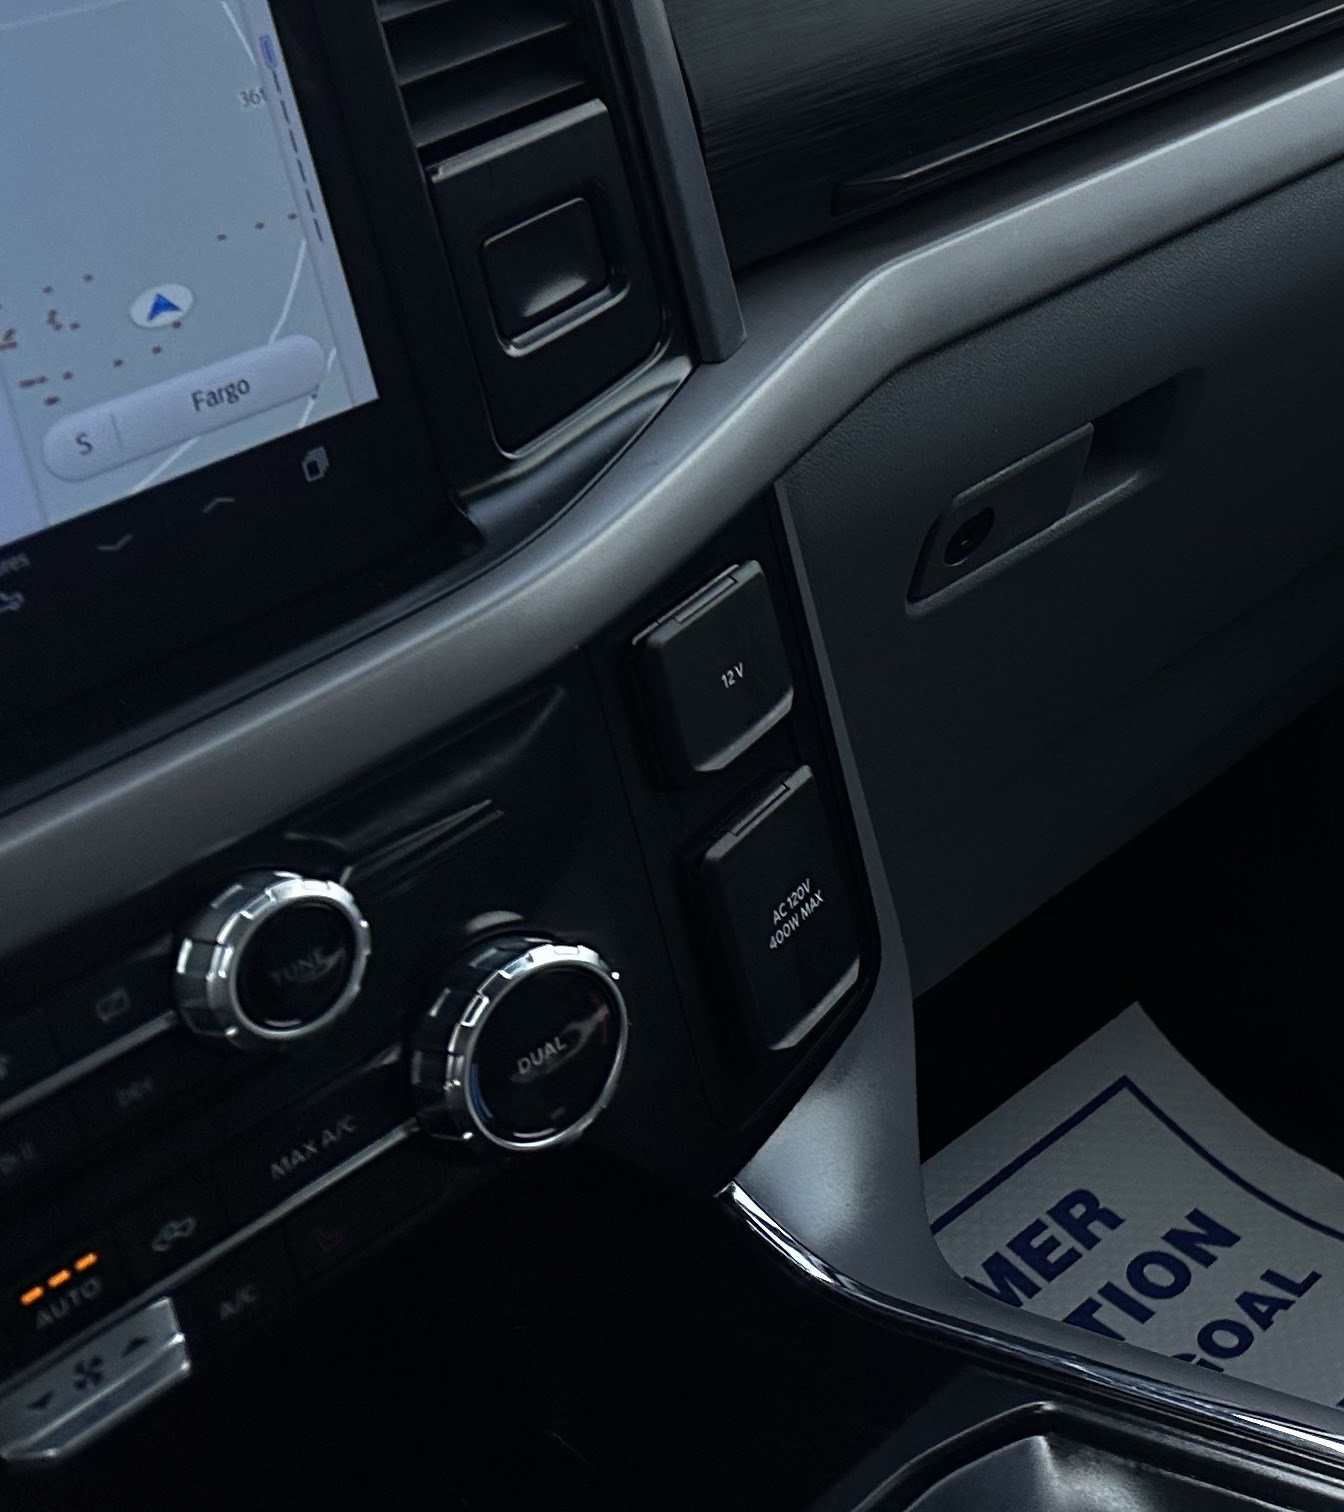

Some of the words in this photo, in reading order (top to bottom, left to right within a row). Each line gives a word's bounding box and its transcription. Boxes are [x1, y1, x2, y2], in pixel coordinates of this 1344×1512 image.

[191, 378, 250, 413] Fargo
[75, 432, 93, 455] S
[768, 918, 801, 951] 400W
[796, 890, 825, 924] MAX
[771, 904, 794, 927] AC
[785, 877, 813, 911] 120V
[273, 947, 329, 984] TUNE
[515, 1035, 567, 1075] DUAL
[269, 1138, 324, 1182] MAX
[323, 1114, 357, 1146] A/C
[964, 1188, 1127, 1309] MER
[1062, 1207, 1242, 1342] TION
[34, 1280, 100, 1329] AUTO
[219, 1285, 258, 1320] A/C
[1172, 1268, 1323, 1373] OAL
